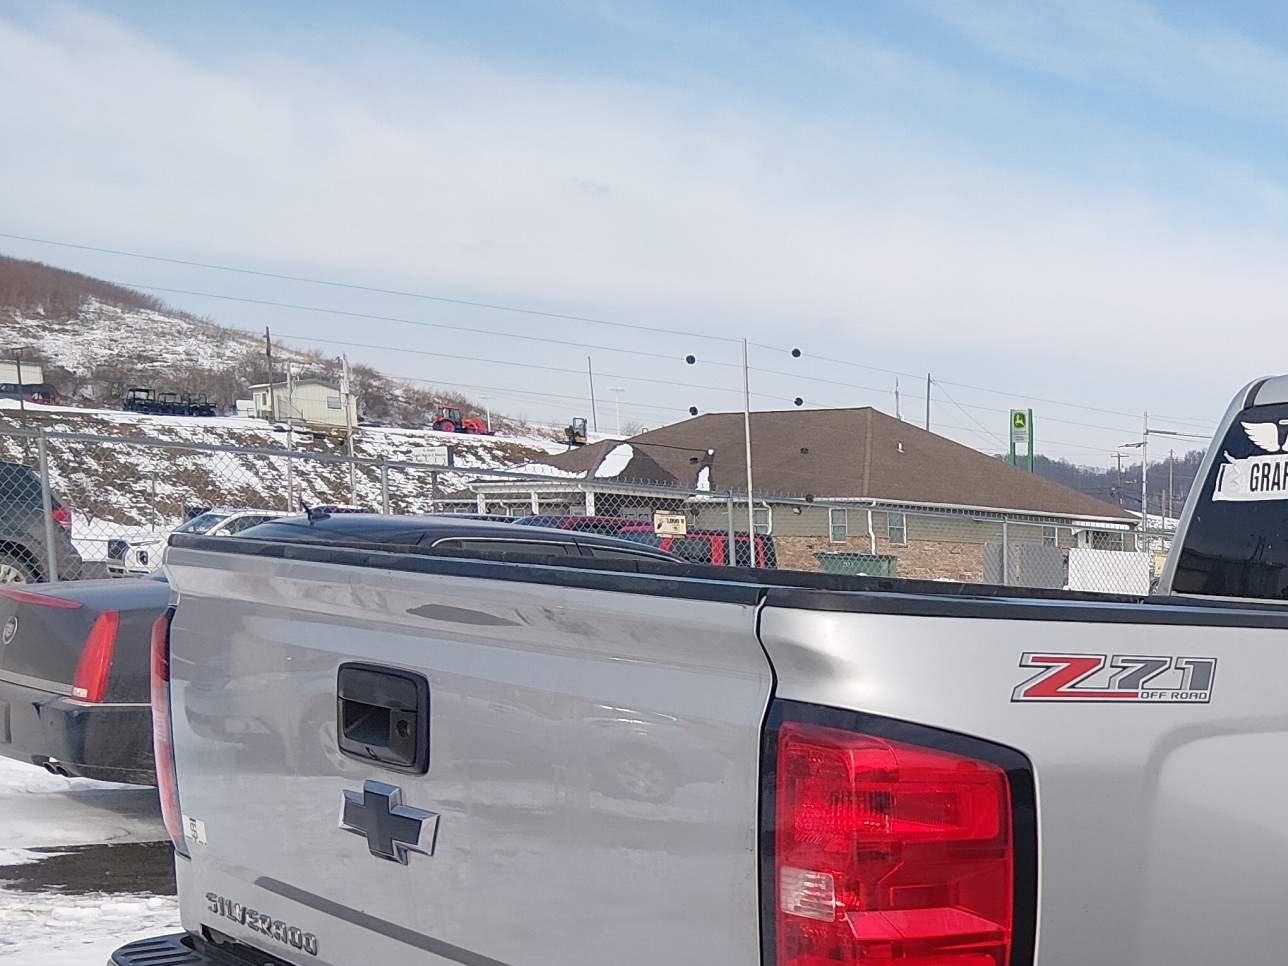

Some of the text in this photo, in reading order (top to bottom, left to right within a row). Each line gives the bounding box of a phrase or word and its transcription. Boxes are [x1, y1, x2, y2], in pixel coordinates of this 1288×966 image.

[1010, 651, 1218, 704] Z71
[1140, 691, 1208, 700] OFF ROAD
[205, 891, 319, 956] SILVERADO
